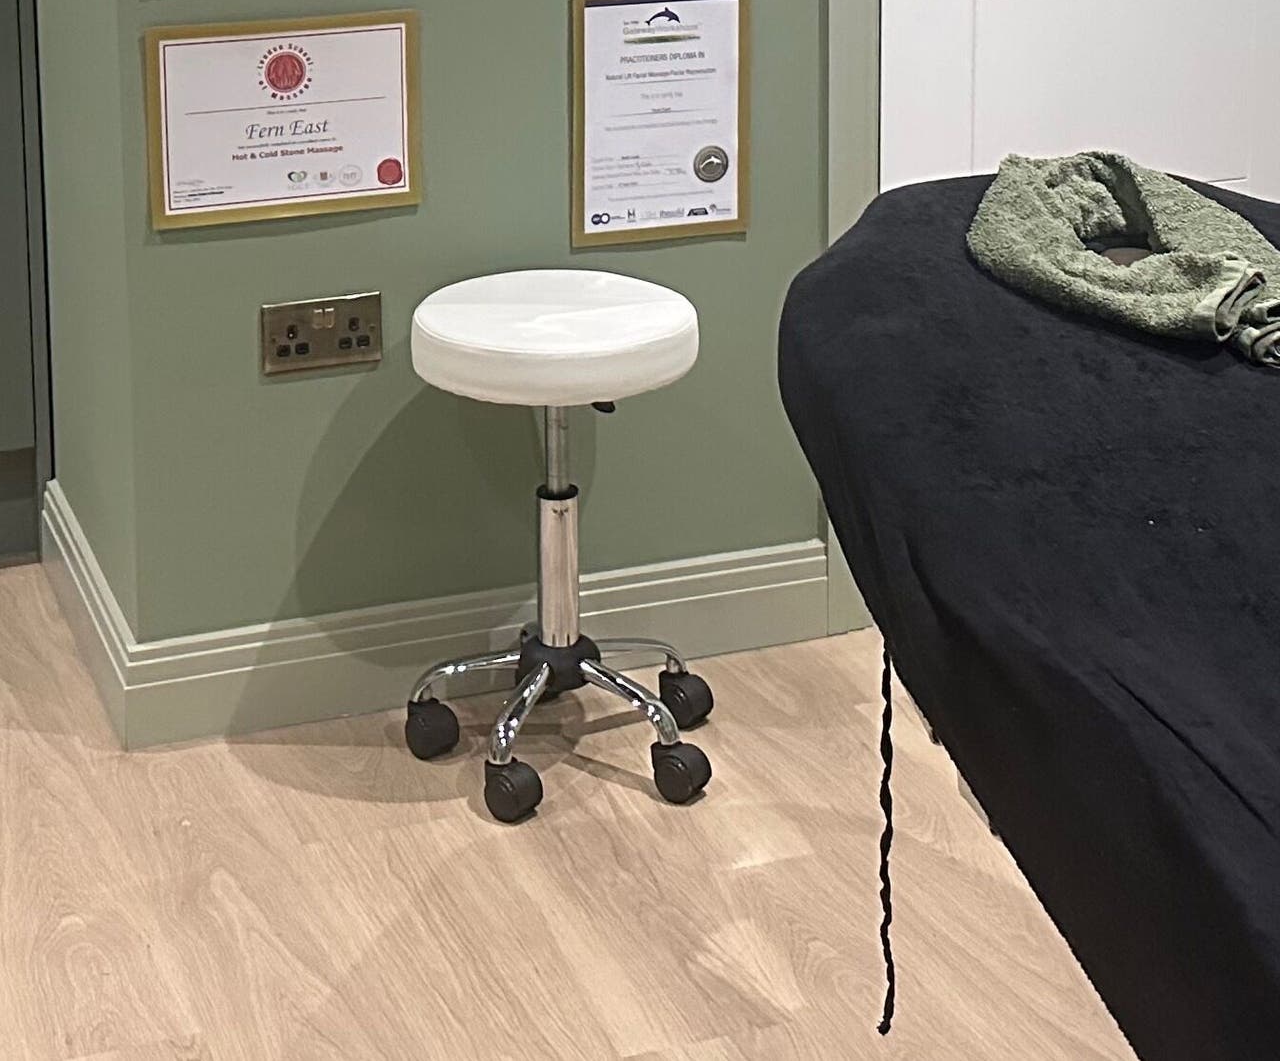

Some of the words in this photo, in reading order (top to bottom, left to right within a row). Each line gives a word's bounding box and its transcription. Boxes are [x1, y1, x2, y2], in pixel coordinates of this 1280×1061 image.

[245, 123, 284, 140] Fern
[289, 119, 330, 136] East
[232, 153, 249, 162] Hot
[250, 151, 257, 160] &
[259, 149, 278, 160] Cold
[280, 148, 305, 158] Stone
[307, 144, 344, 157] Massage
